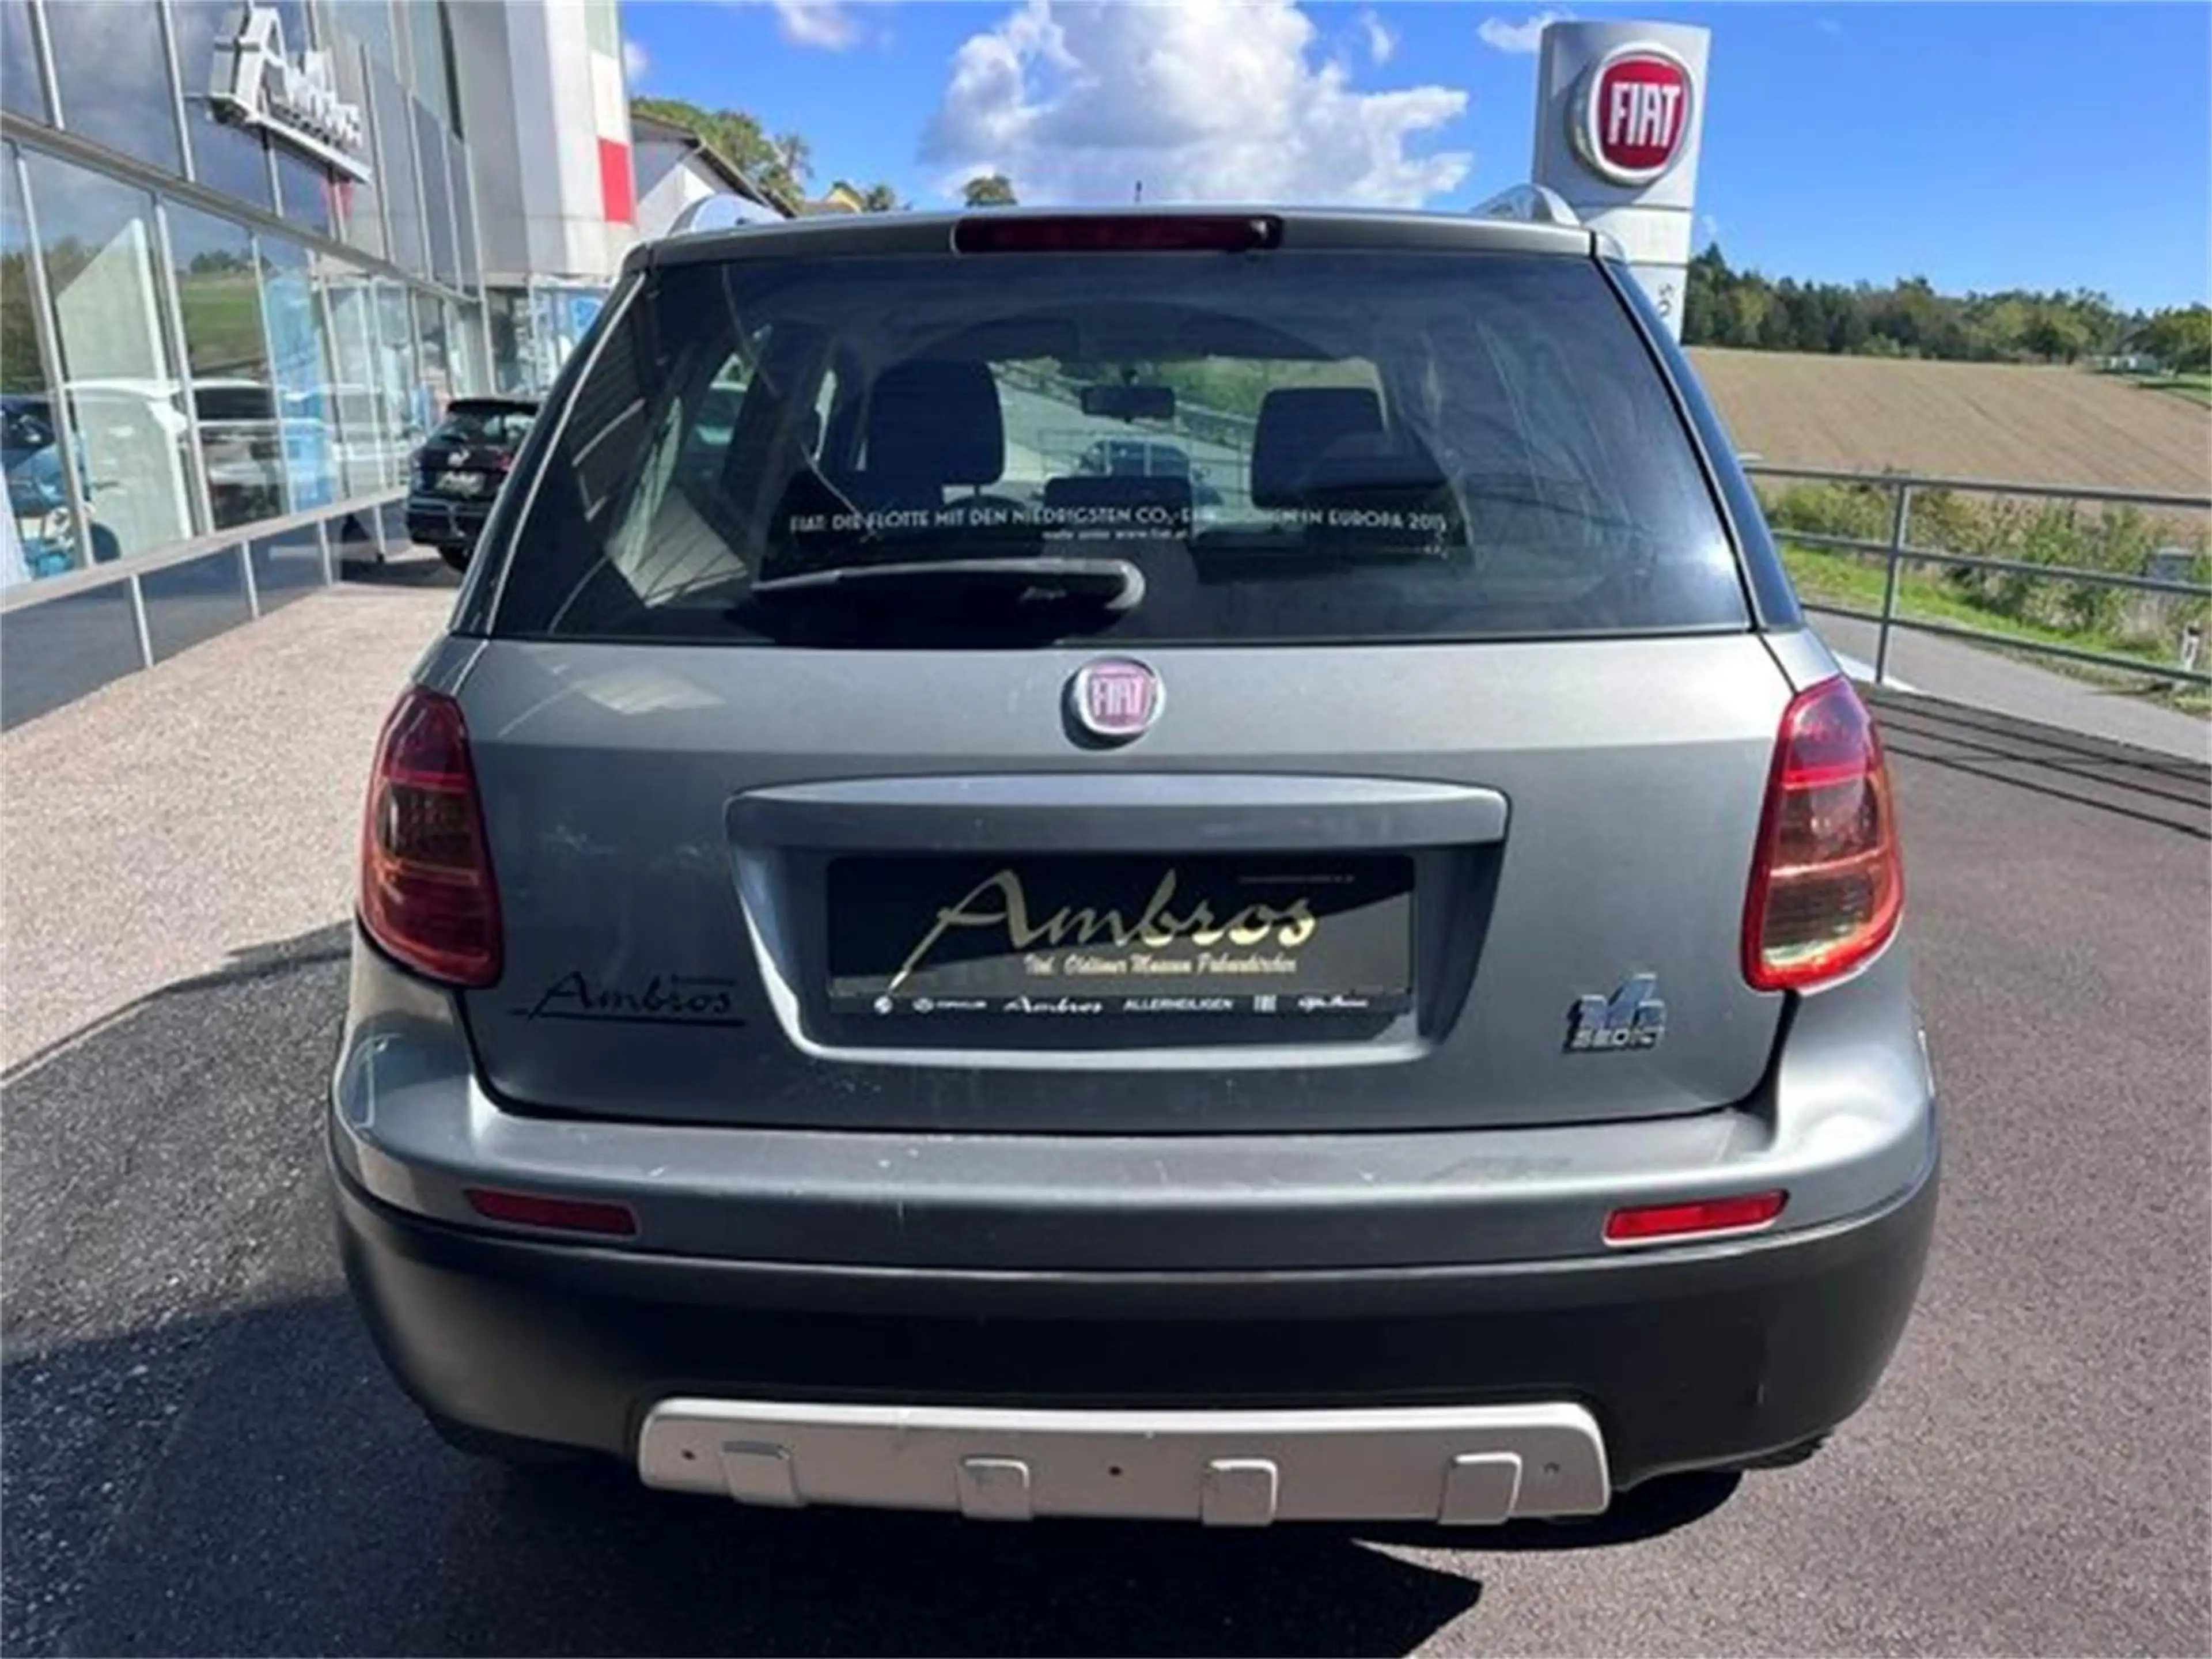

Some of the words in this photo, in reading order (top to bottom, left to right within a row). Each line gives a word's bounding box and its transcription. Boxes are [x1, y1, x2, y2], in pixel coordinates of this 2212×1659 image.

[1608, 81, 1681, 148] FIAT
[934, 508, 964, 527] MIT
[969, 507, 1007, 527] DEN
[1328, 509, 1403, 529] EUROPA
[1091, 677, 1145, 717] FIAT
[887, 866, 1317, 992] Ambros
[510, 971, 735, 1023] Ambros
[1002, 995, 1103, 1013] Ambros
